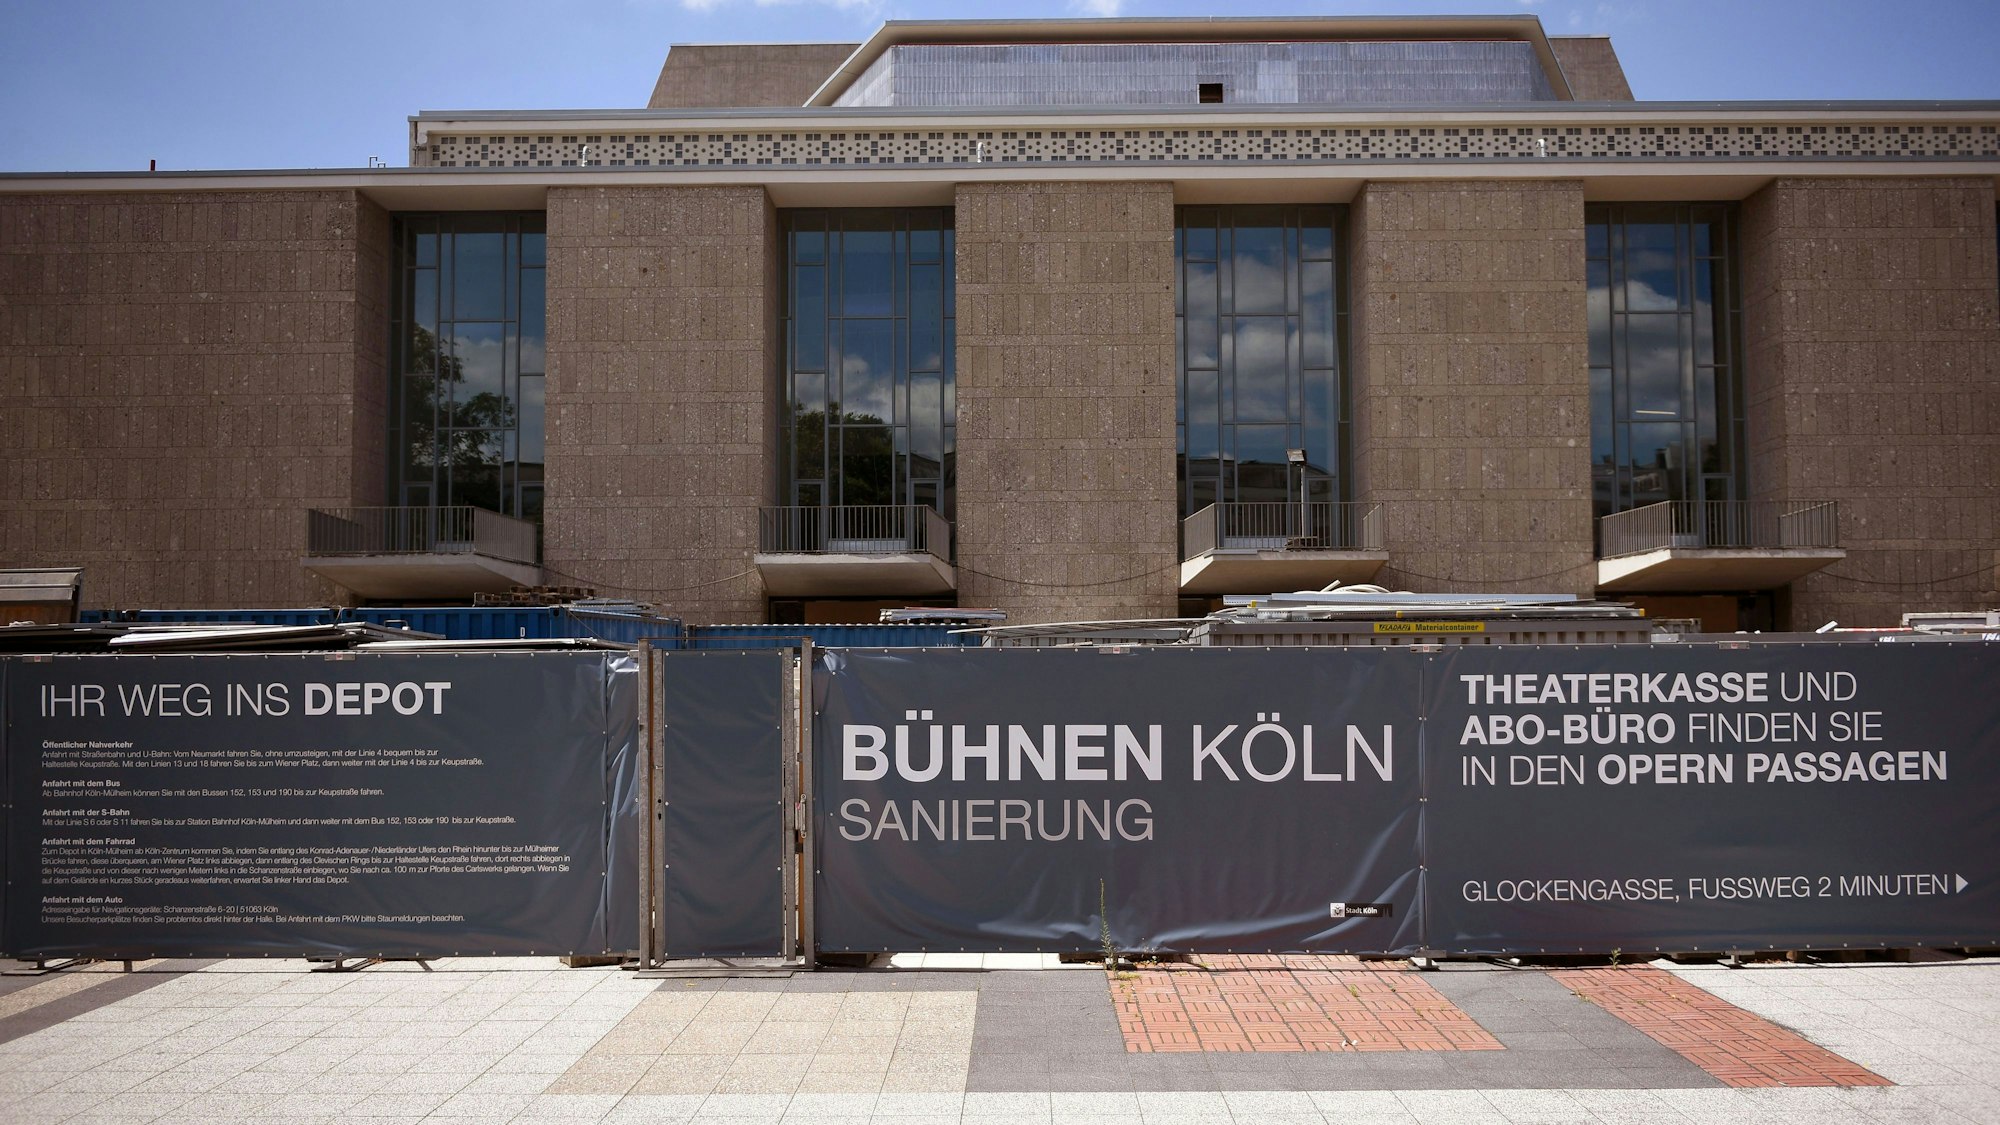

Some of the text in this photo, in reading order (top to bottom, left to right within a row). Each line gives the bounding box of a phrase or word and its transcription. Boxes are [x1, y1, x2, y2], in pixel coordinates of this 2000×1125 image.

[1415, 623, 1479, 631] Materialcontainer
[41, 682, 452, 717] IHR WEG INS DEPOT
[1460, 671, 1857, 704] THEATERKASSE UND
[1459, 706, 1883, 746] ABO-BÜRO FINDEN SIE
[383, 749, 413, 758] bequem
[842, 709, 1393, 783] BÜHNEN KÖLN
[1462, 750, 1947, 786] IN DEN OPERN PASSAGEN
[318, 788, 359, 797] Keupstraße
[839, 798, 1154, 842] SANIERUNG
[1462, 873, 1948, 903] GLOCKENGASSE, FUSSWEG 2 MINUTEN
[165, 915, 202, 924] problemlos
[377, 915, 430, 923] Staumeldungen
[1346, 906, 1378, 914] Stadt Köln
